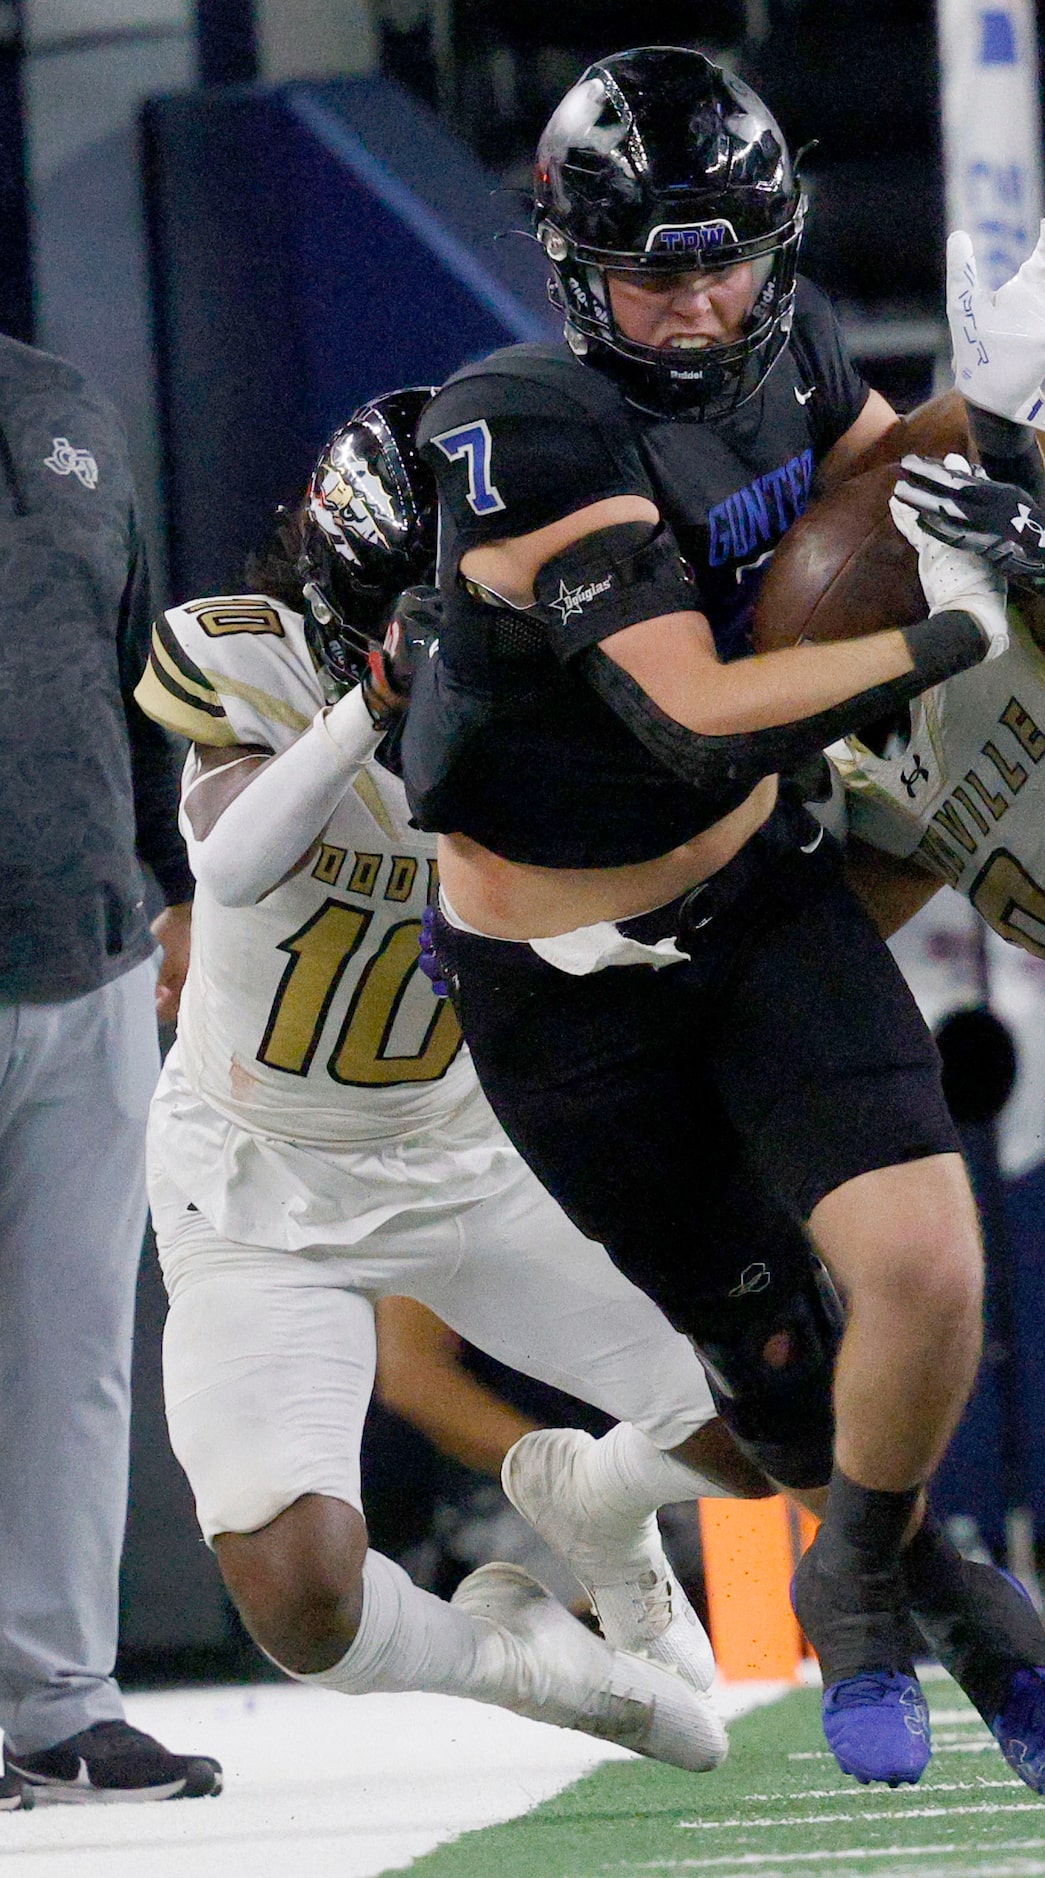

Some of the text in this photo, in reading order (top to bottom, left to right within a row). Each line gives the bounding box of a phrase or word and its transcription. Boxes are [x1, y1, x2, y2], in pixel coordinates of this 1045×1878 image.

[430, 418, 506, 516] 7
[183, 598, 285, 638] 10
[564, 577, 612, 610] Douglas
[256, 897, 464, 1088] 10
